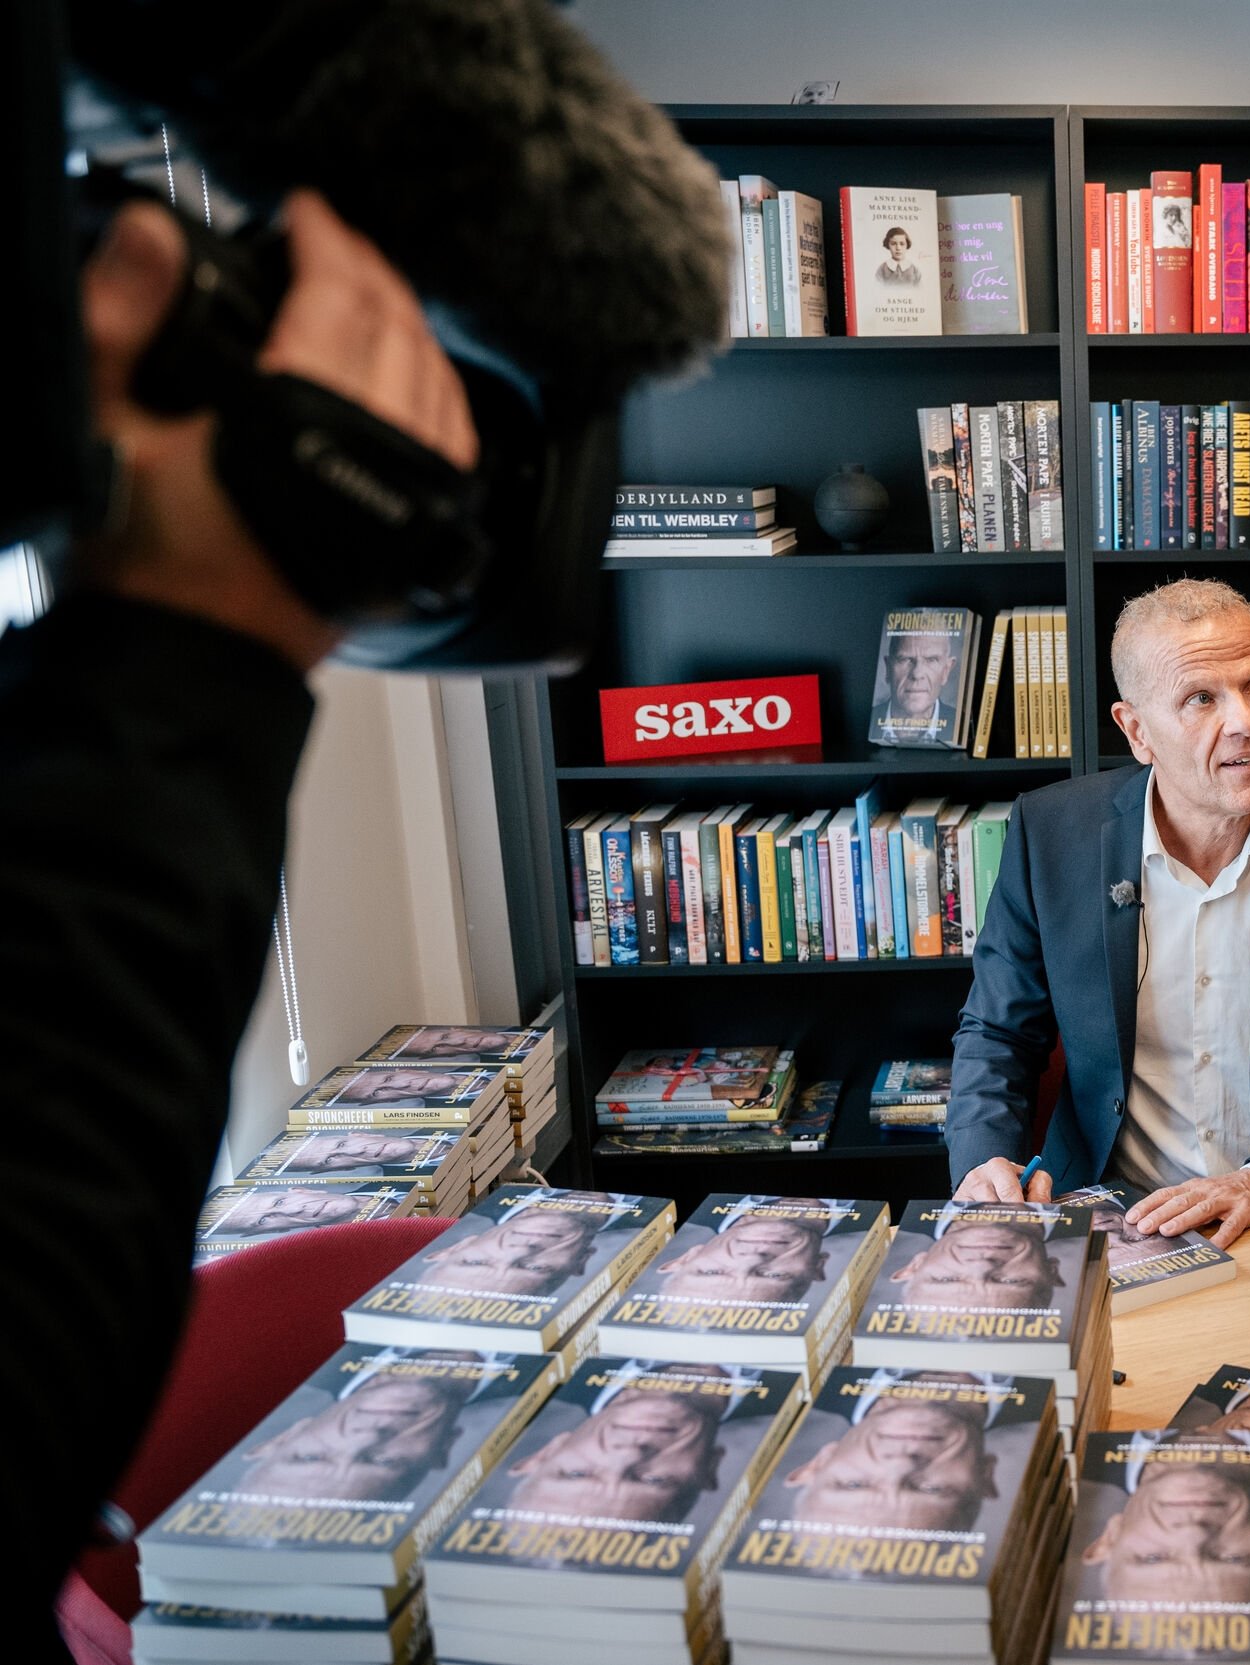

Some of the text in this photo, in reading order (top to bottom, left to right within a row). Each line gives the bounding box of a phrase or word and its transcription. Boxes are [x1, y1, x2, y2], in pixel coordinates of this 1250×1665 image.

[869, 204, 922, 212] MARSTRAND-
[872, 213, 918, 221] JØRGENSEN
[1113, 199, 1121, 247] HEMINGWAY
[1130, 239, 1139, 275] YouTube
[1208, 221, 1216, 300] STÆRK OVERGANG
[1091, 248, 1102, 324] NORDISK SOCIALISME
[1006, 405, 1017, 458] MORTEN PAPE
[1036, 407, 1049, 455] MORTEN
[1137, 408, 1149, 464] ALBINUS
[1147, 424, 1155, 447] IBEN
[1164, 416, 1175, 464] JOJO MOYES
[1188, 446, 1196, 457] er
[1216, 412, 1227, 483] ANE RIEL HARPIKS
[979, 414, 997, 542] MORTEN PAPE PLANEN
[1038, 458, 1049, 485] PAPE
[1188, 458, 1197, 481] hvad
[1202, 412, 1214, 532] ANE RIEL SLAGTEREN LISELEJE
[1233, 452, 1250, 484] MUST
[616, 494, 727, 507] DERJYLLAND
[1142, 467, 1152, 536] DAMASKUS
[1185, 482, 1196, 496] jeg
[1233, 487, 1250, 516] READ
[611, 514, 738, 527] JEN TIL WEMBLEY
[1040, 500, 1051, 538] RUINER
[887, 612, 963, 631] SPIONCHEFEN
[634, 695, 792, 742] saxo
[878, 718, 947, 727] LARS FINDSEN
[606, 838, 619, 883] Ohlsson
[837, 855, 848, 907] HUSTVEDT
[646, 909, 656, 935] KULT
[902, 1094, 942, 1104] LARVERNE
[308, 1111, 374, 1123] SPIONCHEFEN
[499, 1197, 643, 1218] LARS FINDSEN
[711, 1206, 861, 1221] LARS FINDSEN
[920, 1212, 1074, 1226] LARS FINDSEN
[1122, 1257, 1142, 1268] FRA
[1143, 1242, 1203, 1263] ERINDRINGER
[404, 1283, 559, 1304] ERINDRINGER FRA CELLE
[649, 1294, 810, 1310] ERINDRINGER FRA CELLE
[363, 1288, 552, 1326] SPIONCHEFEN
[613, 1301, 806, 1331] SPIONCHEFEN
[895, 1304, 1062, 1316] ERINDRINGER FRA CELLE
[868, 1310, 1062, 1338] SPIONCHEFEN
[341, 1360, 521, 1383] LARS FINDSEN
[585, 1374, 768, 1400] LARS FINDSEN
[840, 1383, 1025, 1406] LARS FINDSEN
[1104, 1450, 1217, 1464] FINDSEN
[162, 1502, 408, 1545] SPIONCHEFEN
[443, 1519, 689, 1570] SPIONCHEFEN
[737, 1531, 985, 1579] SPIONCHEFEN
